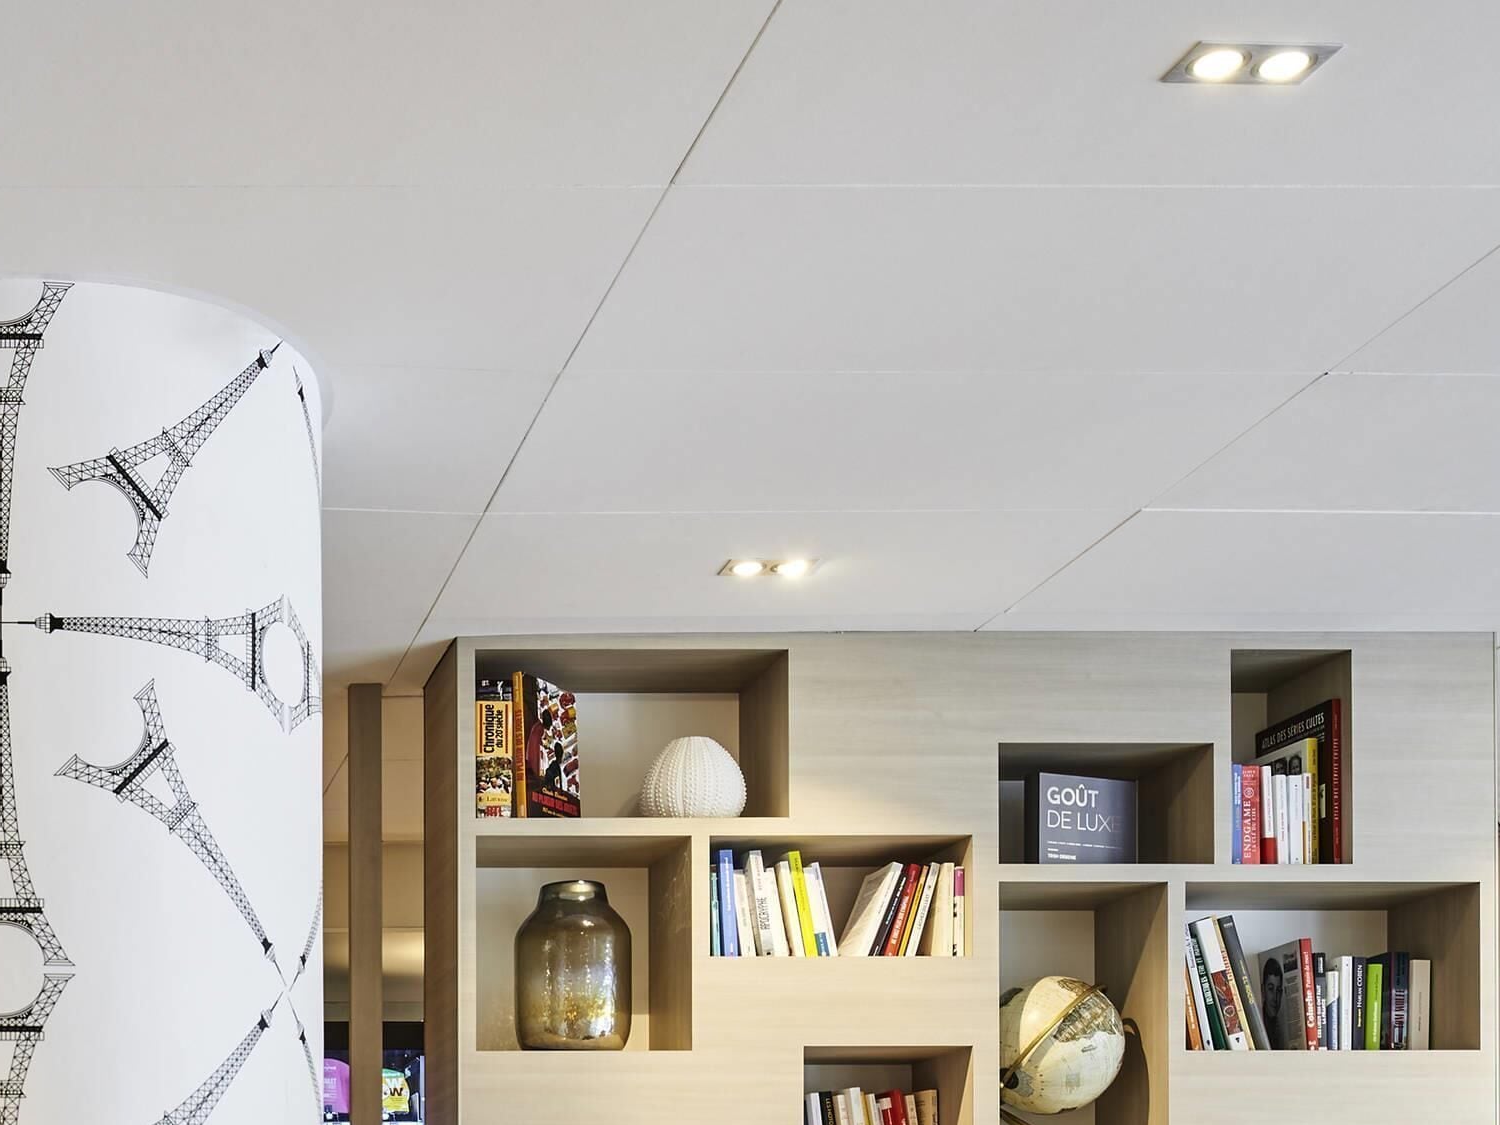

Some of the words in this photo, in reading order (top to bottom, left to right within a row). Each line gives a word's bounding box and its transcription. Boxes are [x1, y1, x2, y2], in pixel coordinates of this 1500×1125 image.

[483, 705, 495, 753] Chronique
[495, 710, 503, 729] siècle
[1277, 728, 1287, 743] DES
[1287, 721, 1304, 738] SÉRIES
[1306, 712, 1325, 730] CULTES
[495, 740, 503, 748] du
[515, 733, 523, 745] DES
[515, 746, 524, 772] PLAISIR
[1047, 784, 1099, 808] GOÛT
[1047, 810, 1072, 829] DE
[1077, 812, 1121, 833] LUXE
[1243, 800, 1251, 858] ENDGAME
[1305, 990, 1315, 1027] Coluche
